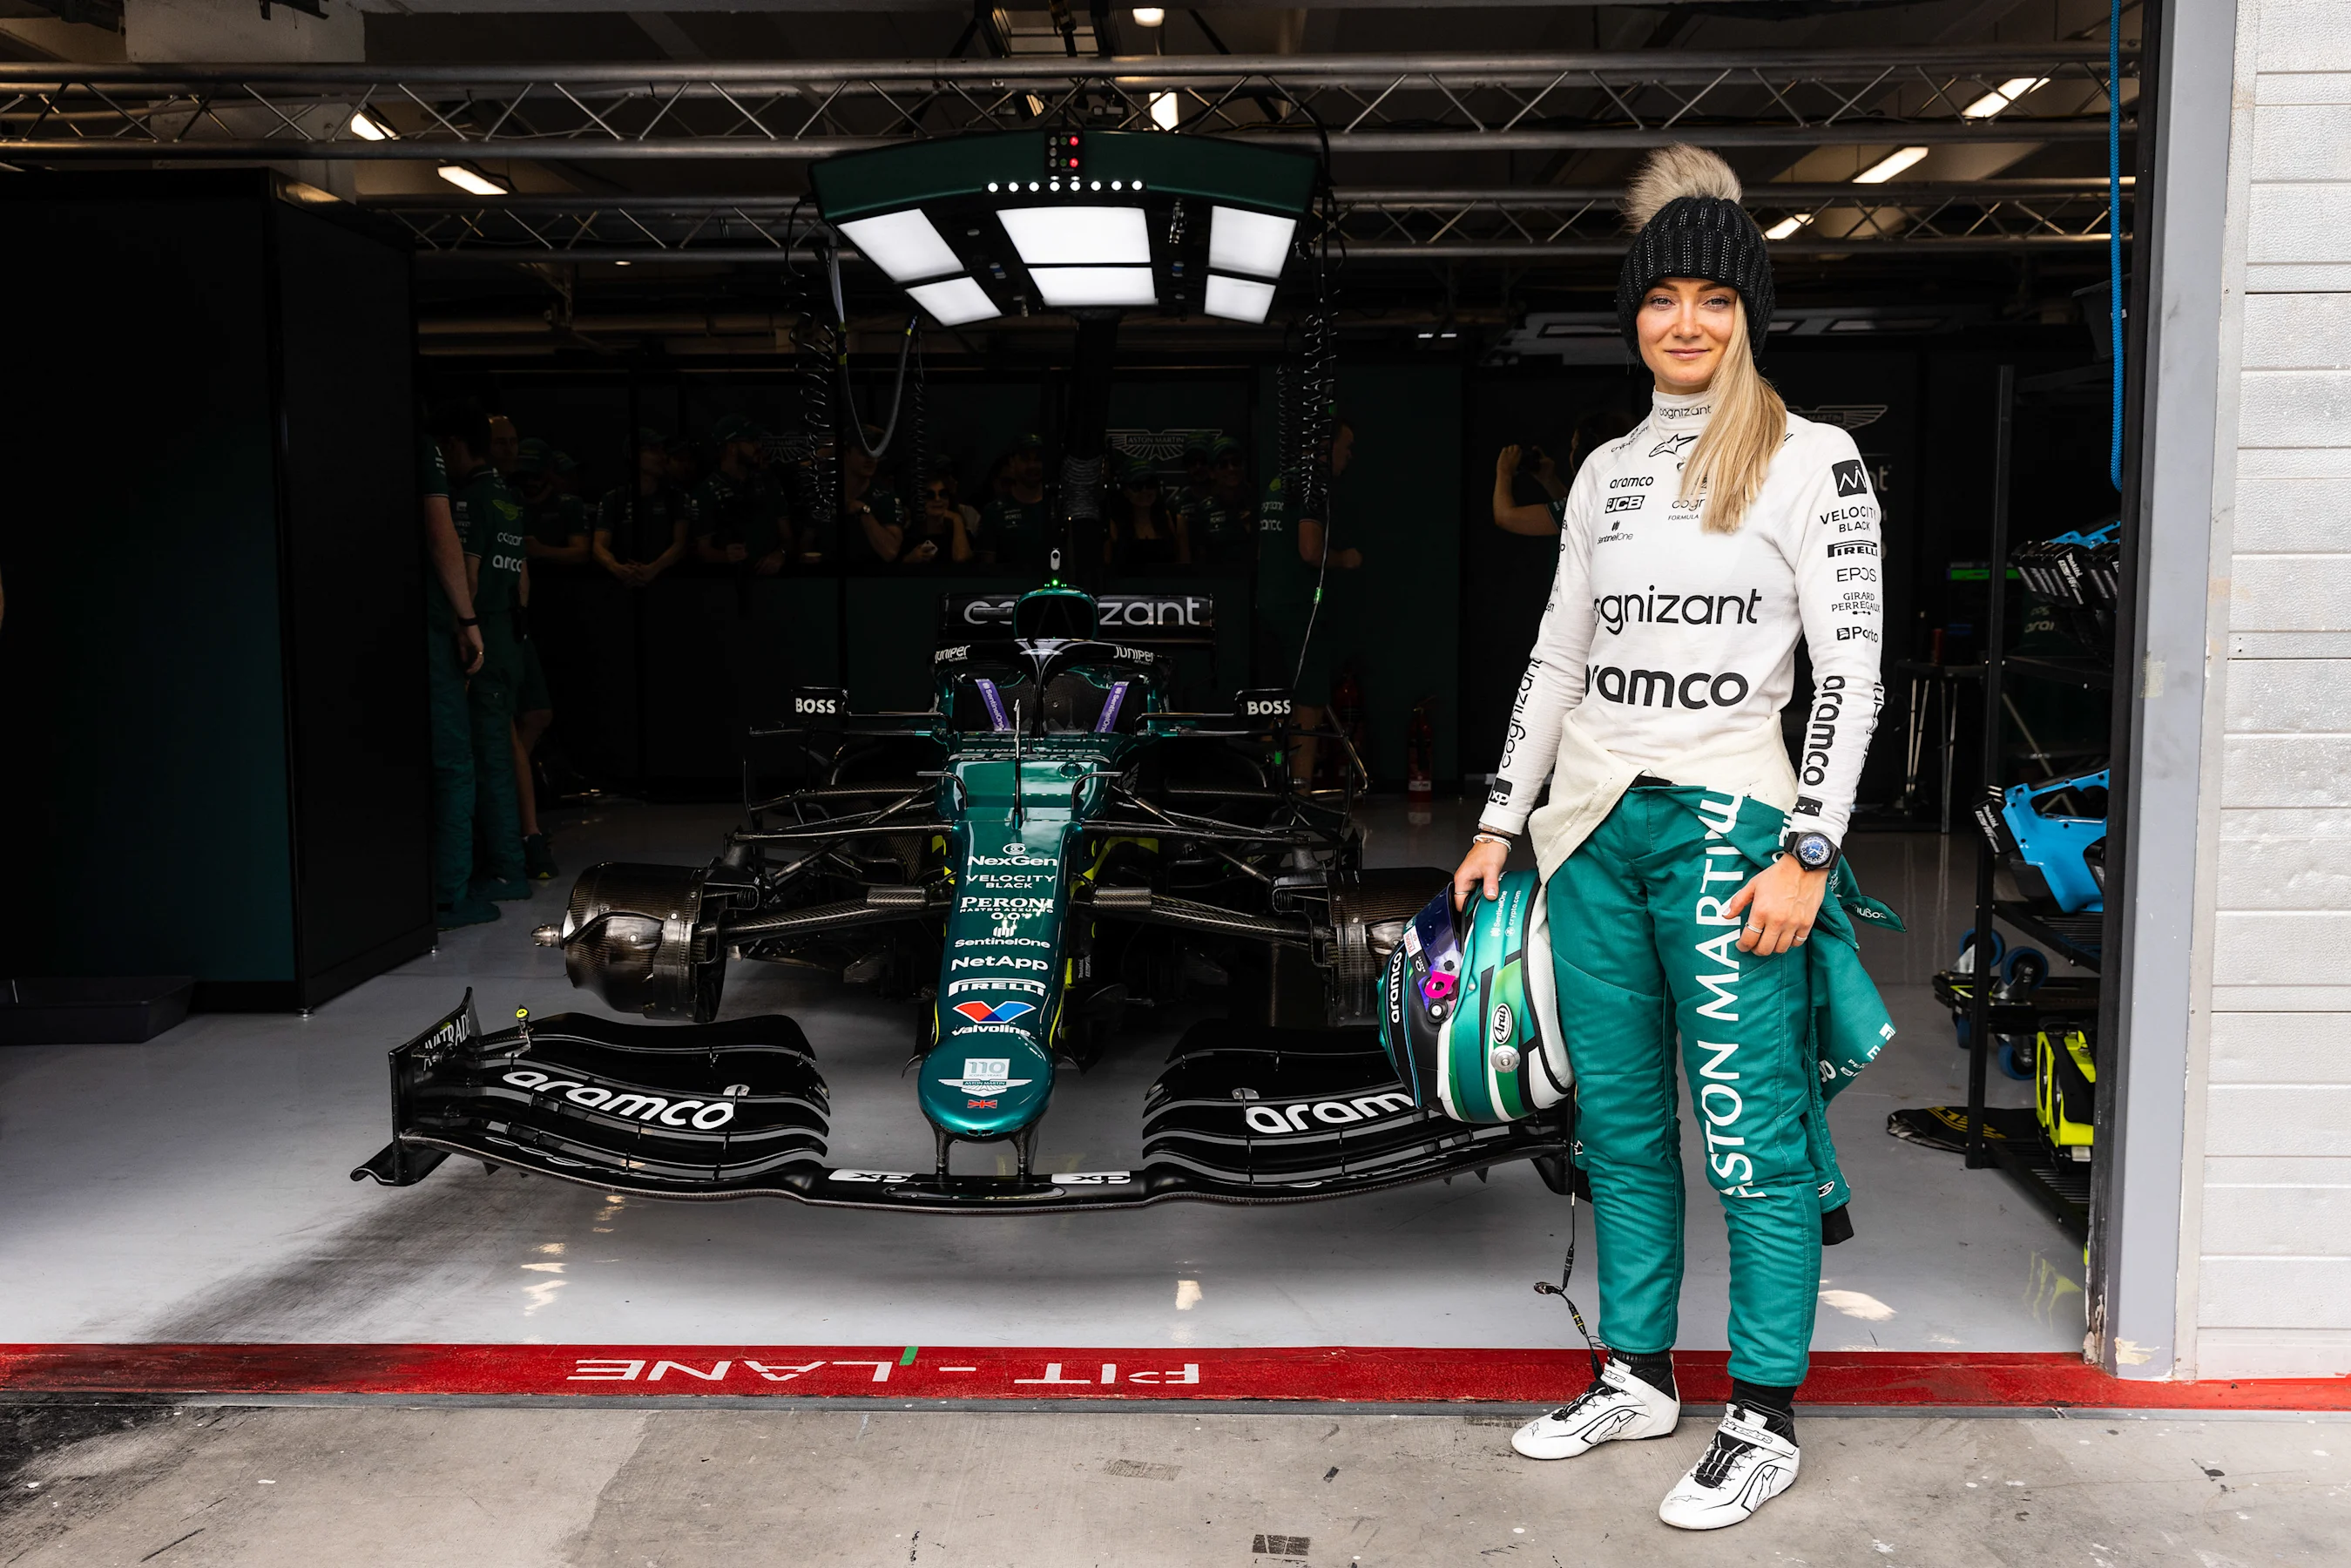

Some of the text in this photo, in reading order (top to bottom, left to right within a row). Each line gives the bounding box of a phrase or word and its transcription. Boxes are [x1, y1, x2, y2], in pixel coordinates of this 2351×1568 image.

[1659, 404, 1713, 420] cognizant
[1610, 476, 1653, 489] aramco
[1606, 496, 1644, 513] JCB
[1839, 521, 1871, 533] BLACK
[1827, 539, 1878, 558] PIRELLI
[1843, 591, 1875, 601] GIRARD
[1852, 626, 1879, 643] Porto
[795, 698, 836, 713] BOSS
[985, 689, 1004, 730] SentinelOne
[1246, 700, 1291, 715] BOSS
[1802, 675, 1846, 786] aramco
[967, 855, 1057, 866] NexGen
[960, 896, 1054, 909] PERONI
[1494, 890, 1508, 927] SentinelOne
[1508, 890, 1522, 925] crypto.com
[955, 937, 1051, 949] SentinelOne
[950, 955, 1049, 971] NetApp
[948, 977, 1046, 997] PIRELLI
[1389, 951, 1403, 1024] aramco
[1493, 1008, 1509, 1043] Arai
[968, 1061, 1006, 1074] 110
[502, 1071, 734, 1130] aramco
[566, 1360, 894, 1382] LANE
[1014, 1362, 1199, 1385] PIT
